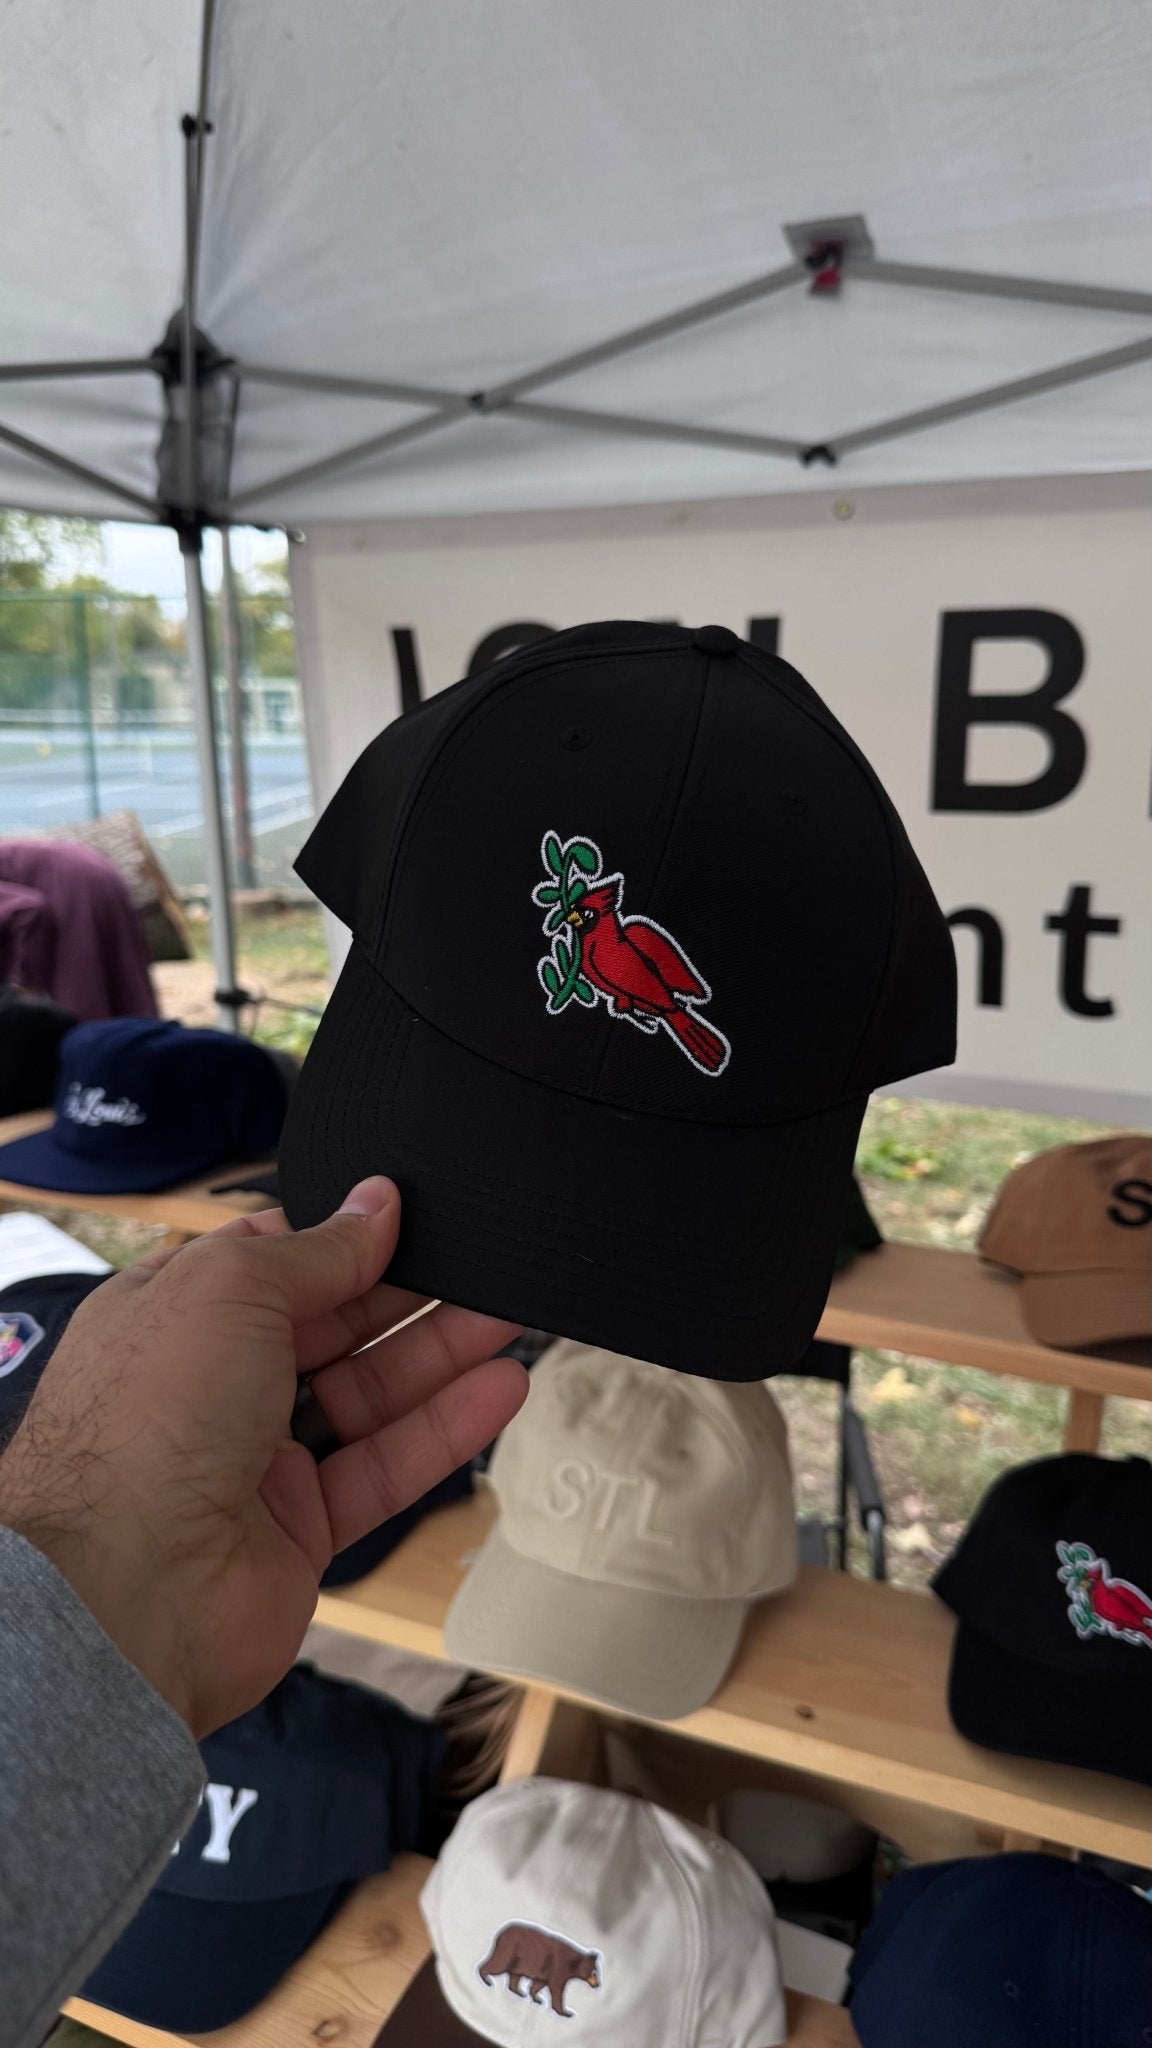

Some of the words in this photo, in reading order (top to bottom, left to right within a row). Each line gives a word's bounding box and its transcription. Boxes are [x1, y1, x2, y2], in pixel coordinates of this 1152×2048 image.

[929, 608, 1152, 818] B
[543, 1457, 679, 1549] STL
[171, 1783, 260, 1865] Y
